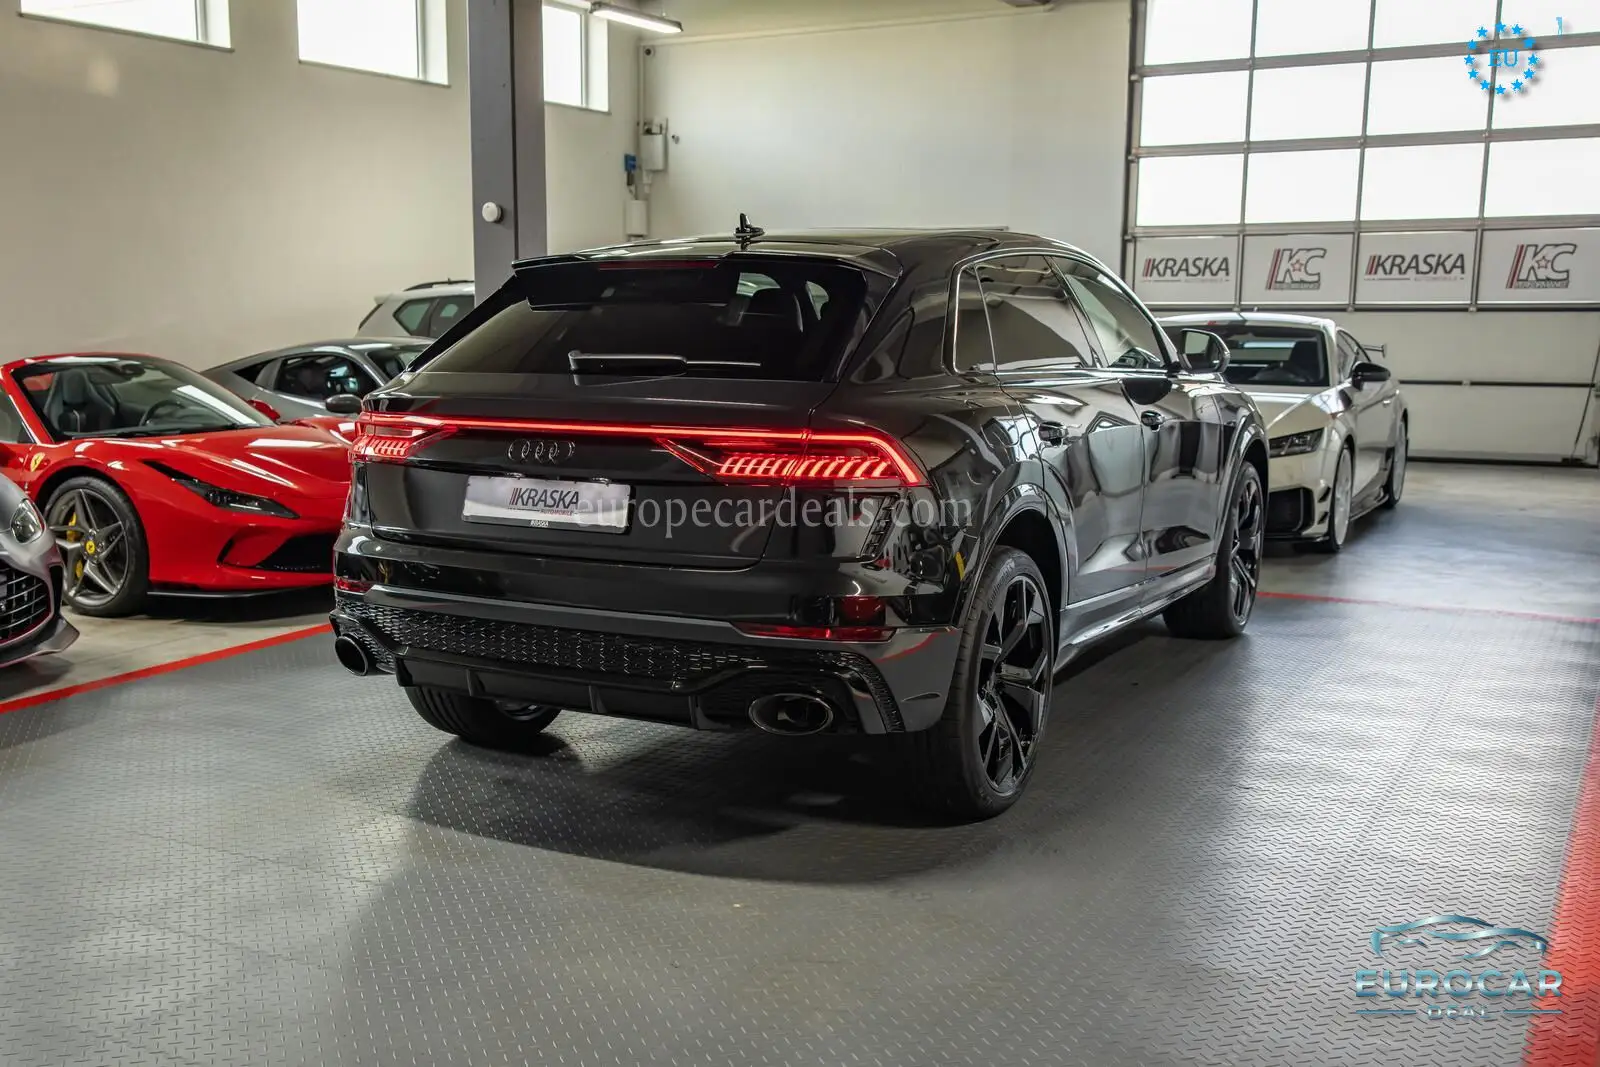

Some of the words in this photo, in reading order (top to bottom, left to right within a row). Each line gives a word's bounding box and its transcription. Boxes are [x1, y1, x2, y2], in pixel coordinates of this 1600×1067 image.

[1149, 256, 1230, 277] KRASKA
[1374, 253, 1466, 276] KRASKA
[516, 487, 580, 509] KRASKA
